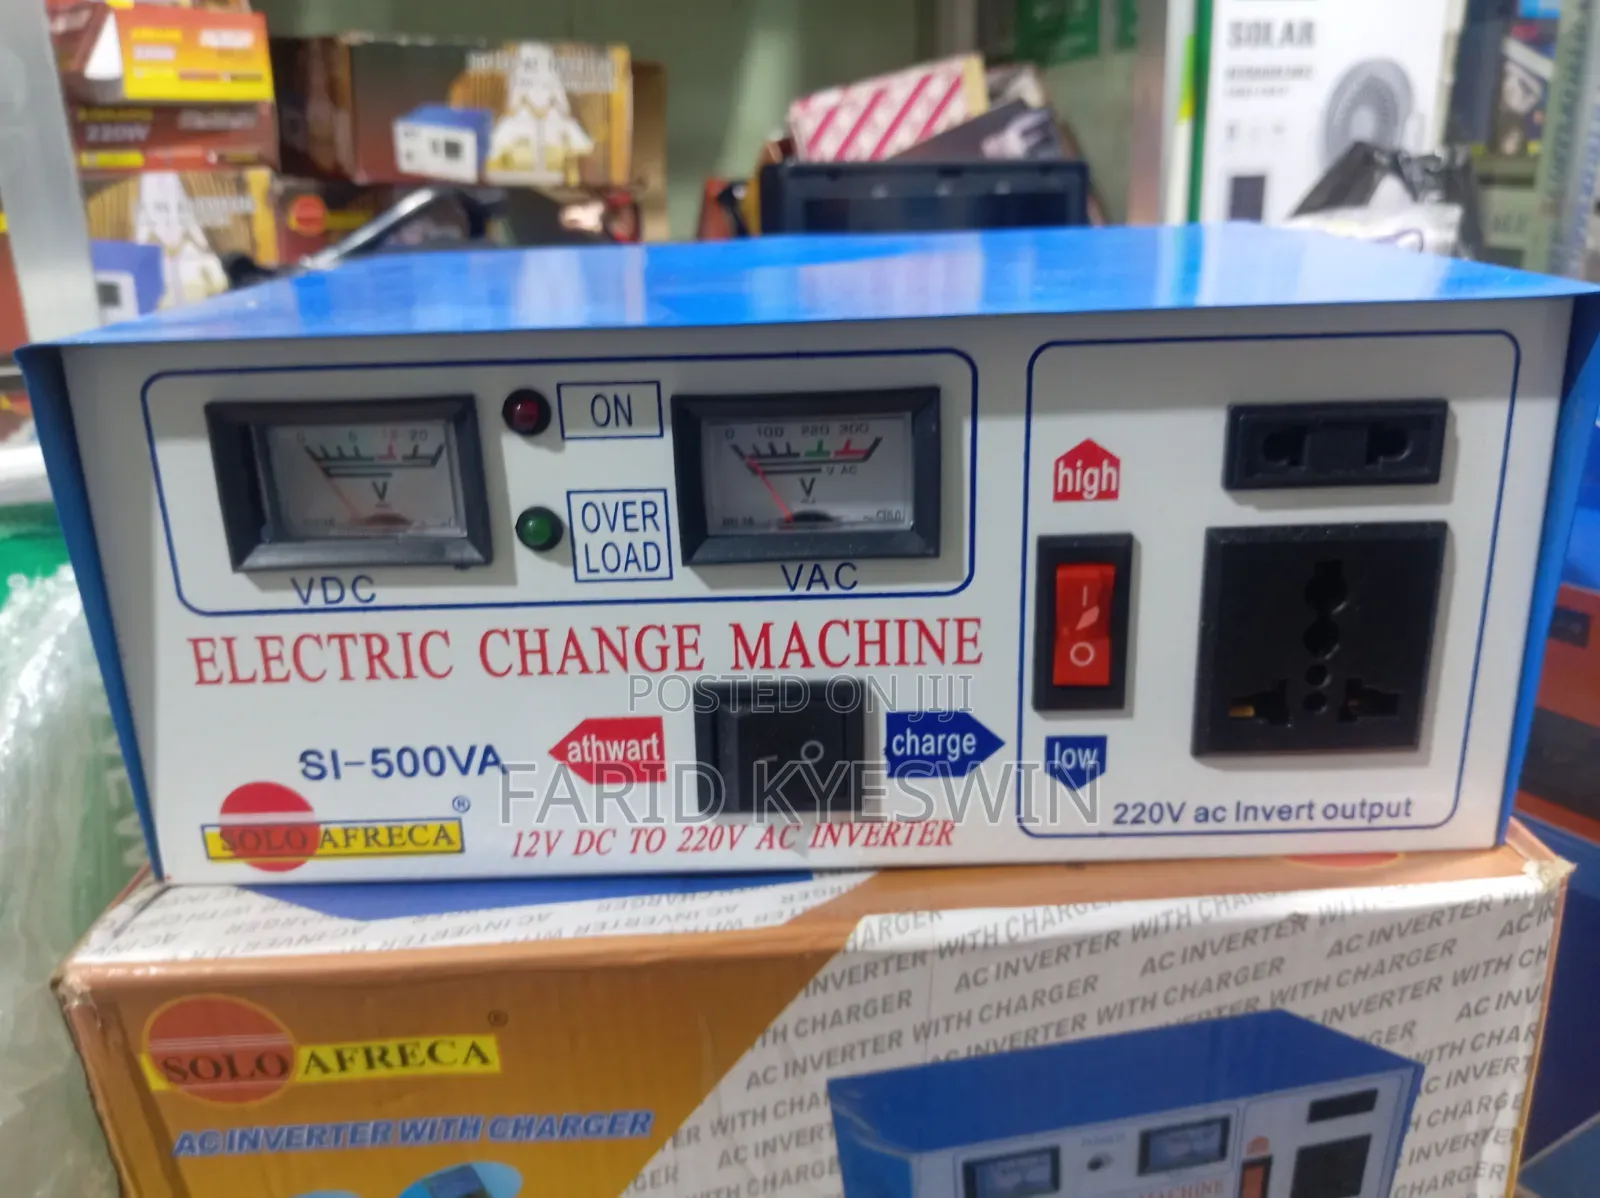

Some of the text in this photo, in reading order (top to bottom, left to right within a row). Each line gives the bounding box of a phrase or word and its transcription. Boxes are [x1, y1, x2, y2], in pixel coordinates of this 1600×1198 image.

[590, 394, 633, 428] ON
[1057, 460, 1119, 499] high
[581, 500, 661, 533] OVER
[585, 541, 662, 574] LOAD
[780, 561, 858, 592] VAC
[291, 574, 376, 606] VDC
[187, 617, 983, 686] ELECTRIC CHANGE MACHINE
[299, 744, 508, 782] SI-500VA
[567, 729, 976, 764] athwart charge
[1053, 741, 1099, 770] low
[1112, 798, 1413, 826] 220V ac Invert output
[218, 822, 456, 853] SOLO AFRECA
[511, 820, 957, 859] 12V DC TO 220V AC INVERTER
[1139, 951, 1175, 978] AC
[1180, 911, 1308, 965] INVERTER
[1326, 932, 1363, 960] AC
[1368, 894, 1494, 948] INVERTER
[1497, 910, 1532, 941] AC
[803, 950, 929, 999] INVERTER
[938, 922, 999, 960] WITH
[954, 965, 990, 994] AC
[994, 929, 1121, 982] INVERTER
[1131, 903, 1192, 944] WITH
[1097, 991, 1157, 1027] WITH
[1163, 955, 1286, 1007] CHARGER
[1269, 975, 1330, 1012] WITH
[1336, 937, 1458, 989] CHARGER
[1321, 974, 1443, 1027] INVERTER
[1452, 950, 1513, 988] WITH
[794, 988, 913, 1039] CHARGER
[1455, 995, 1490, 1023] AC
[746, 974, 1099, 1092] AC INVERTER WITH CHARGER
[162, 1040, 491, 1085] SOLO AFRECA
[173, 1109, 655, 1157] AC INVERTER WITH CHARGER
[709, 1106, 767, 1138] WITH
[717, 1145, 749, 1171] AC
